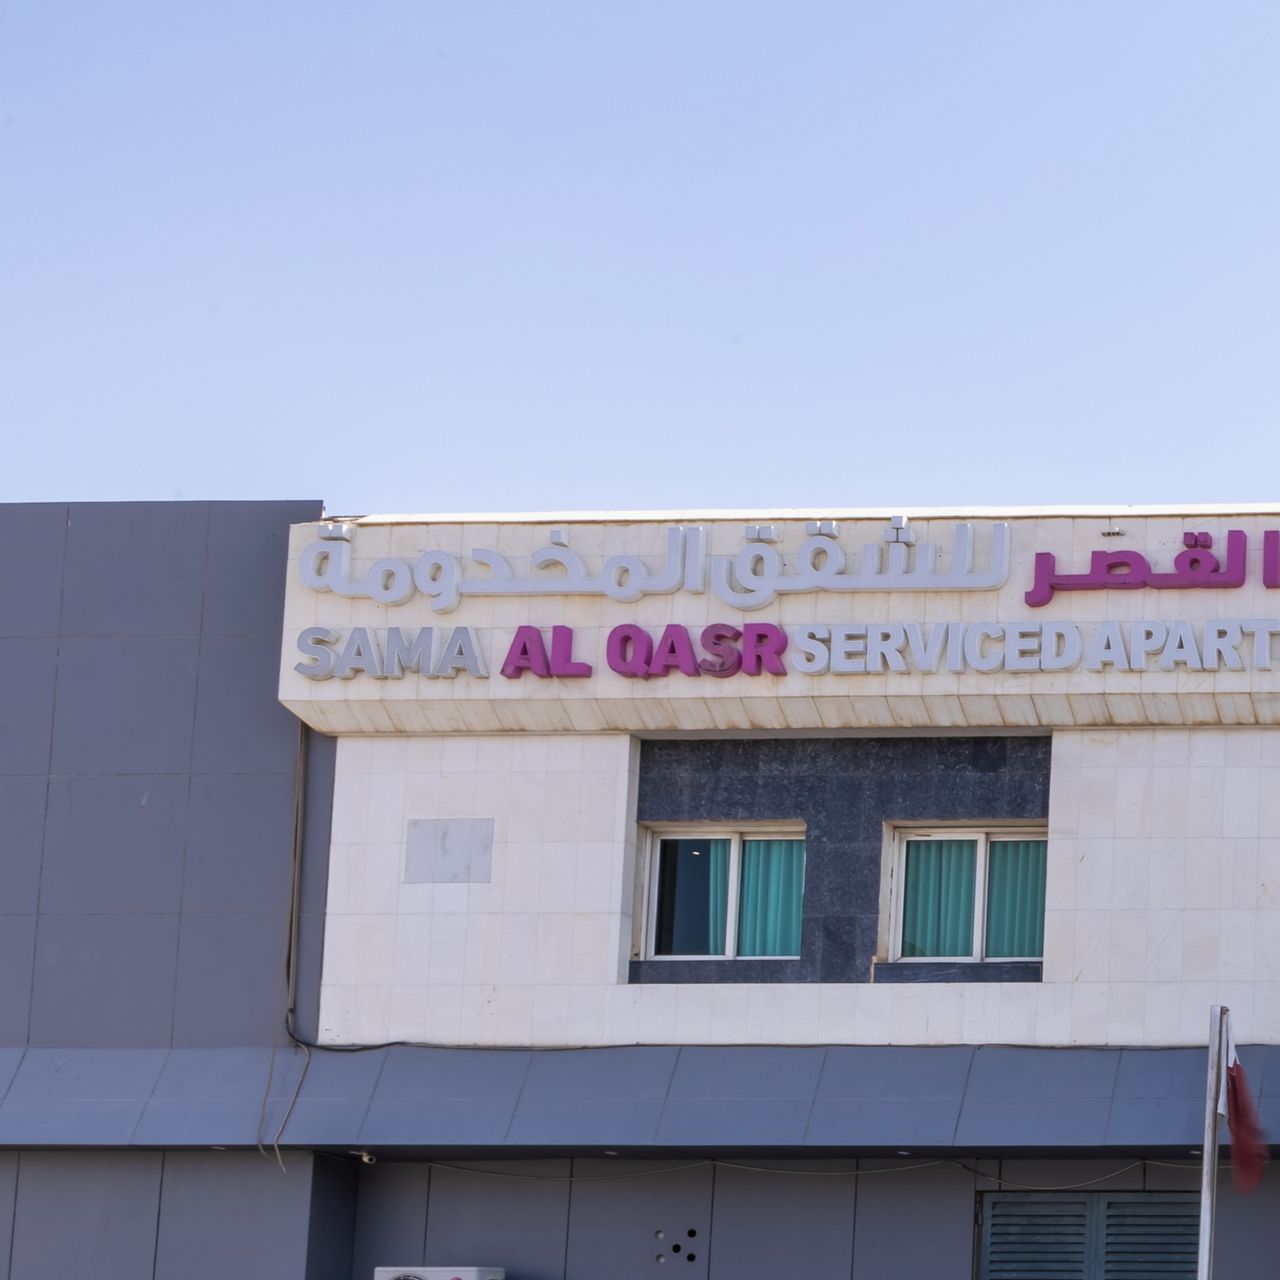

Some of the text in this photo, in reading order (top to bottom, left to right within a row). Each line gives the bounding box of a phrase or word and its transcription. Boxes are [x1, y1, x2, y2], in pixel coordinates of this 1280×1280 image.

[299, 523, 707, 615] المخدومة
[711, 515, 1013, 611] للشقق
[294, 626, 490, 680] SAMA
[500, 624, 593, 680] AL
[606, 623, 788, 682] QASR
[792, 619, 1084, 678] SERVICED
